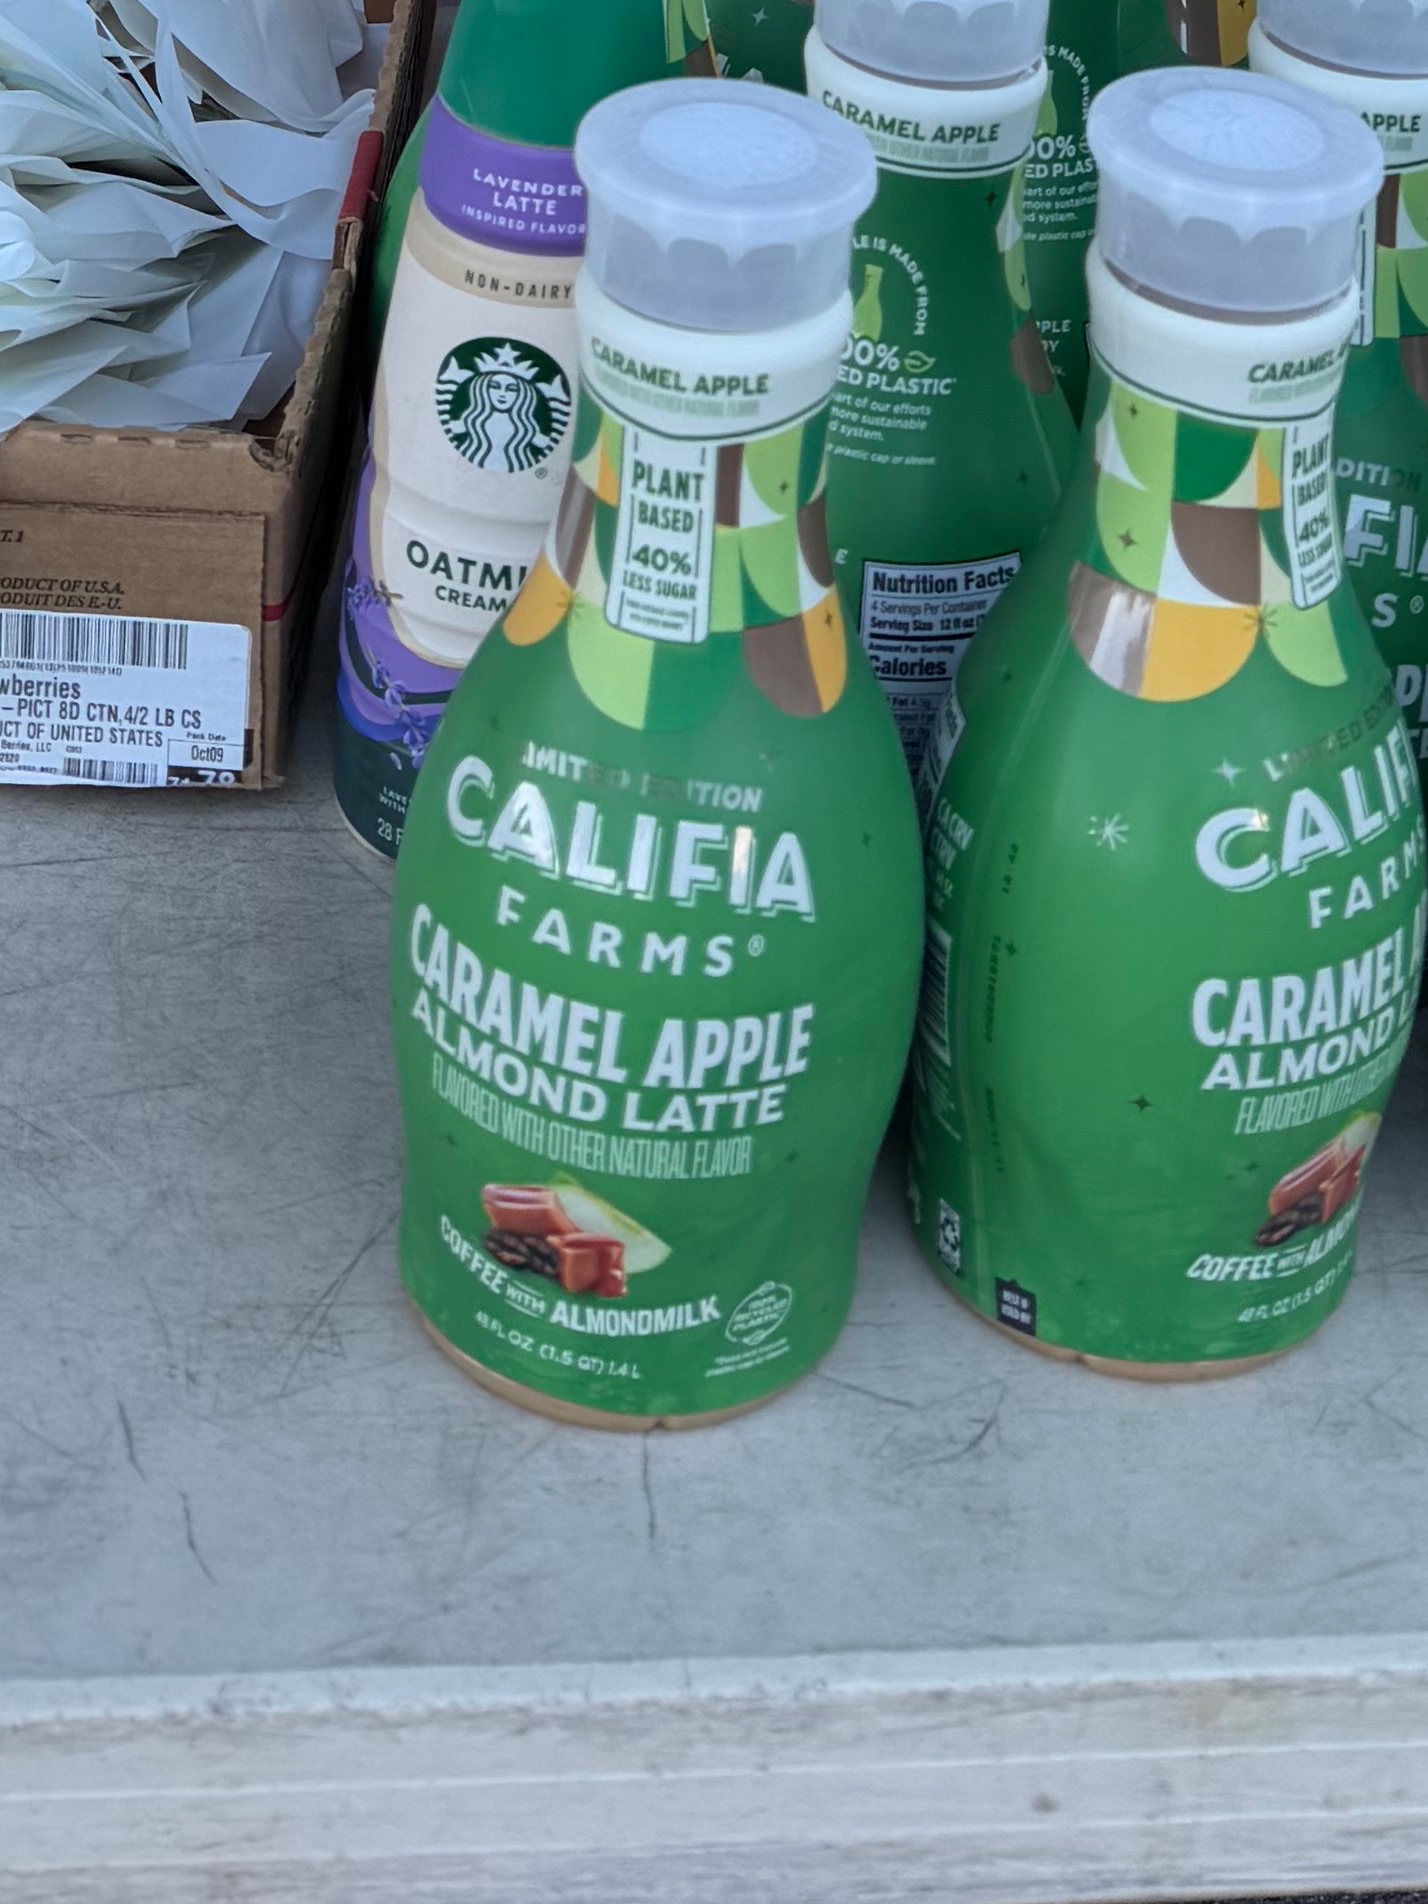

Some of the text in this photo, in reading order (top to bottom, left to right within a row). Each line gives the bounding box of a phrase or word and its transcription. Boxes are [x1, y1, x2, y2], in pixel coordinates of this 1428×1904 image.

[1057, 47, 1087, 78] MADE
[823, 89, 1001, 144] CARAMEL APPLE
[1360, 111, 1421, 135] APPLE
[473, 168, 583, 197] LAVENDER
[462, 204, 525, 231] INSPIRED
[493, 192, 557, 216] LATTE
[465, 269, 572, 300] NON-DAIRY
[873, 236, 930, 336] IS MADE FROM
[591, 336, 687, 393] CARAMEL
[693, 373, 770, 396] APPLE
[1248, 349, 1335, 383] CARAMEL
[855, 396, 931, 416] of our efforts
[861, 413, 927, 430] sustainable
[1293, 433, 1329, 479] PLANT
[632, 459, 704, 501] PLANT
[638, 500, 694, 533] BASED
[632, 544, 692, 576] 40%
[59, 578, 82, 593] OF
[84, 580, 125, 595] U.S.A.
[623, 570, 697, 600] LESS SUGAR
[873, 565, 1014, 593] Nutrition Facts
[54, 593, 84, 608] DES
[880, 602, 922, 617] Servings
[924, 602, 939, 614] Per
[870, 617, 951, 633] Serving Size 12
[869, 655, 947, 675] Calories
[155, 707, 202, 729] LB CS
[27, 723, 46, 741] OF
[50, 724, 104, 744] UNITED
[109, 727, 163, 747] STATES
[35, 741, 52, 753] LLC
[190, 744, 224, 762] Oct09
[1195, 719, 1420, 893] CALIF
[446, 754, 816, 923] CALIFIA
[496, 884, 735, 979] FARMS
[410, 903, 815, 1089] CARAMEL APPLE
[1192, 927, 1404, 1048] CARAMEL
[411, 987, 789, 1133] ALMOND LATTE
[1200, 1006, 1395, 1091] ALMOND
[432, 1052, 753, 1179] FLAVORED WITH OTHER NATURAL FLAVOR
[1234, 1086, 1319, 1135] FLAVORED
[441, 1214, 721, 1337] COFFEE WITH ALMONDMILK
[1186, 1252, 1279, 1282] COFFEE
[490, 1318, 506, 1339] FL
[508, 1331, 533, 1353] OZ
[539, 1343, 573, 1367] (1.5
